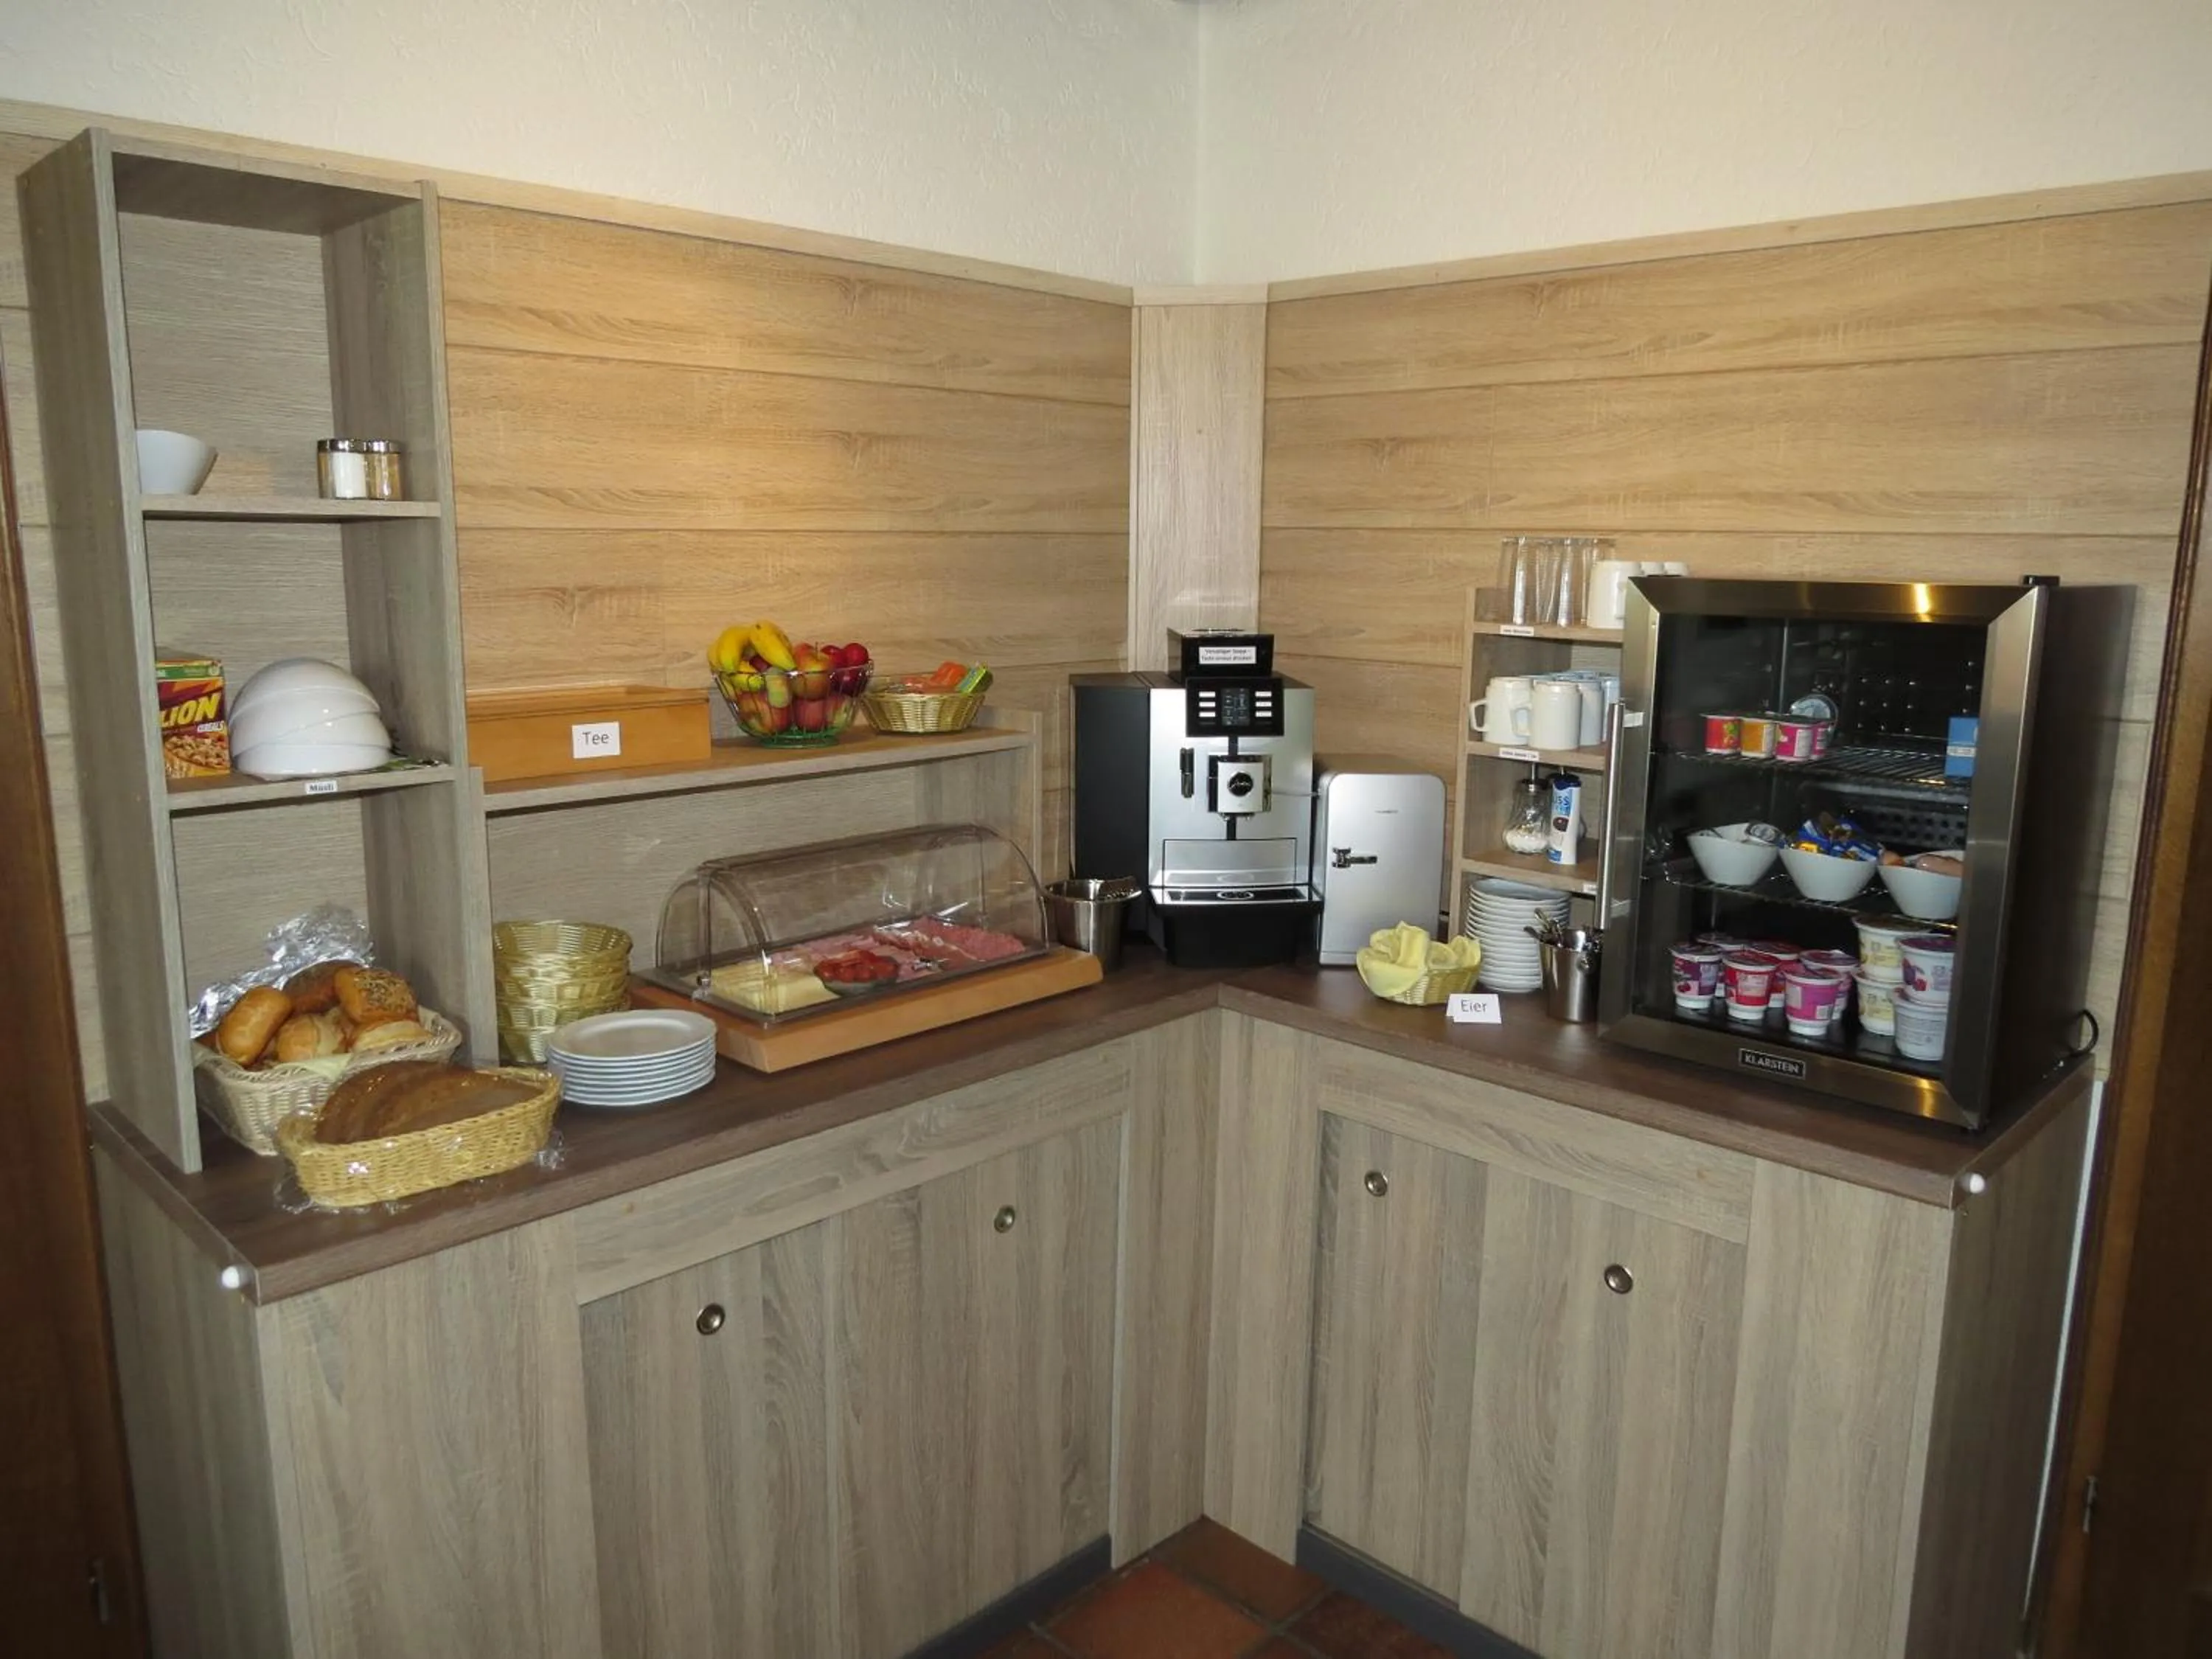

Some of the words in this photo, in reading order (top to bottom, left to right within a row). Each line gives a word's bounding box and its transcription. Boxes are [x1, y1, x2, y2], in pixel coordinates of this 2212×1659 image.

[582, 731, 610, 745] Tee
[1461, 999, 1486, 1012] Eier
[1745, 1052, 1799, 1074] KLARSTEIN
